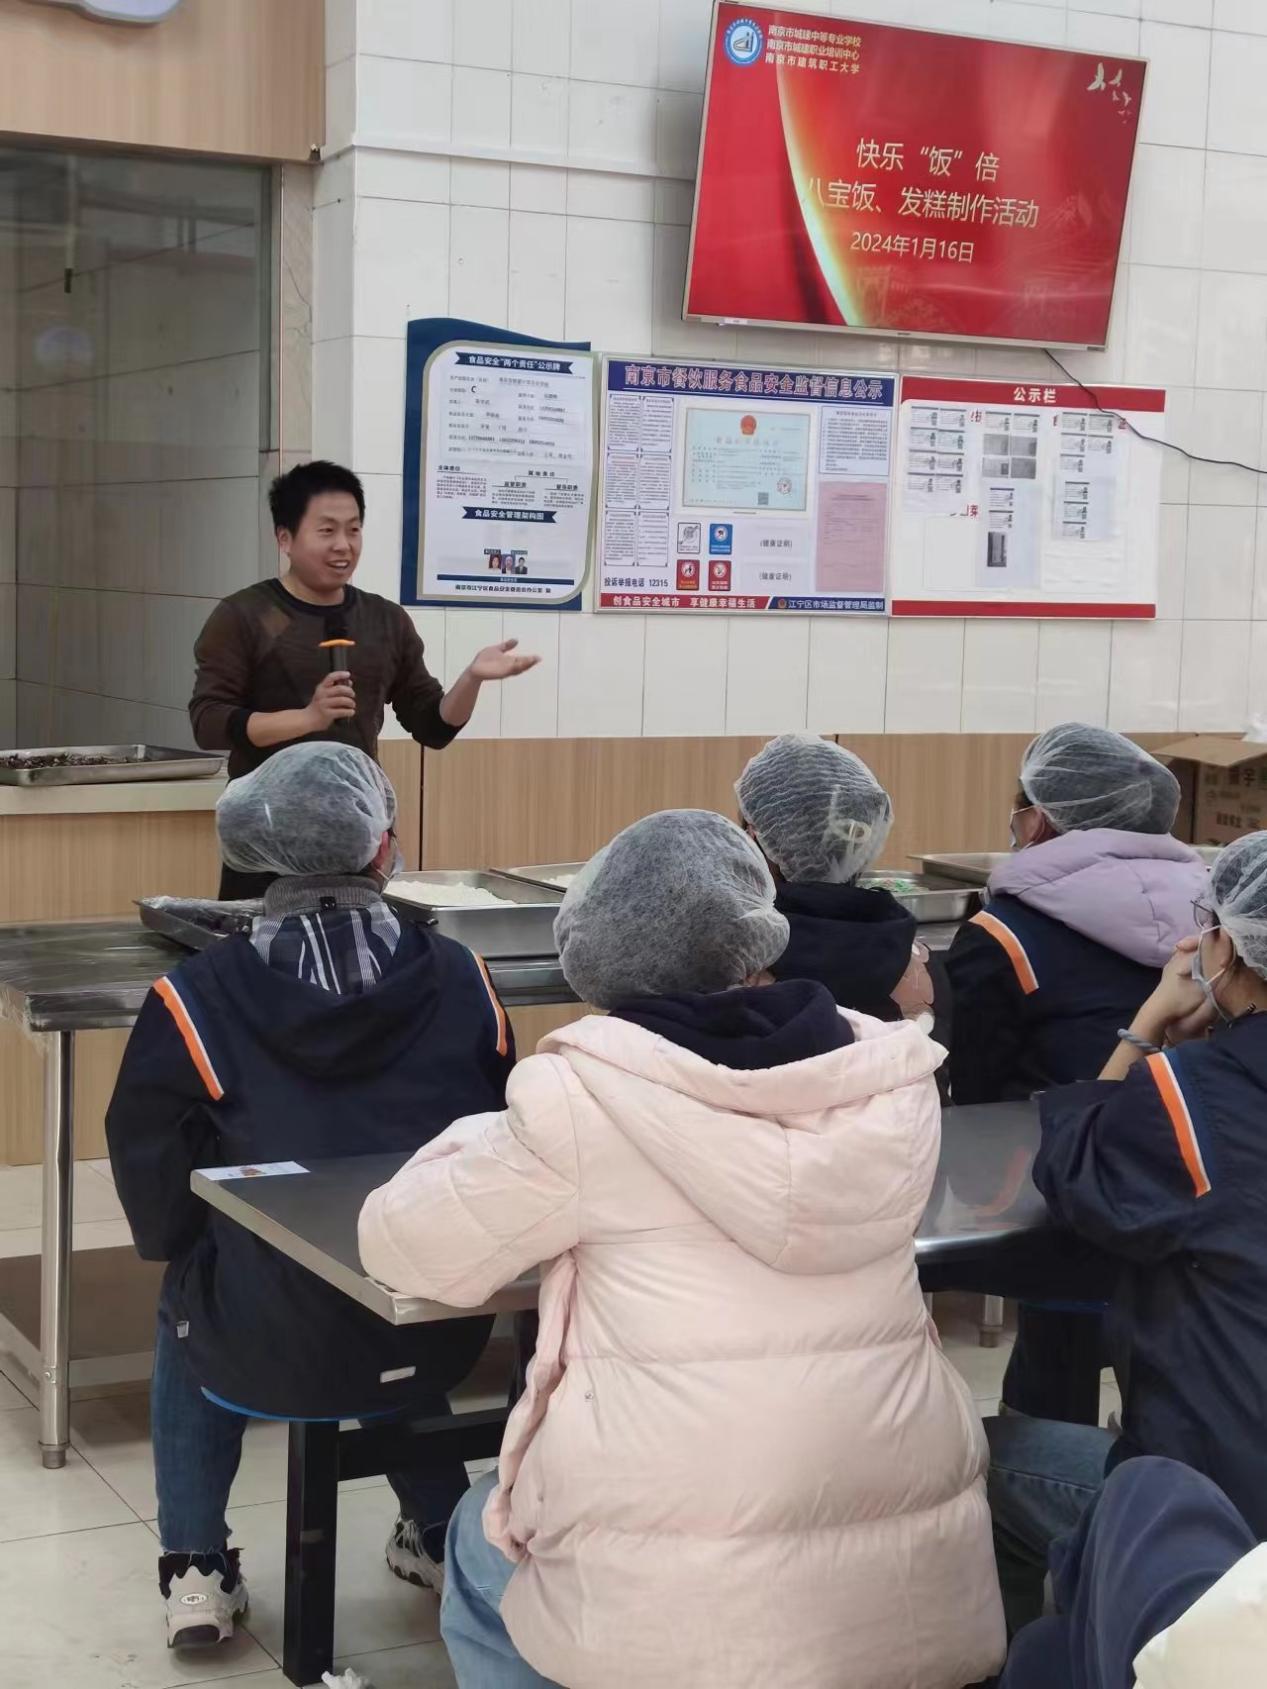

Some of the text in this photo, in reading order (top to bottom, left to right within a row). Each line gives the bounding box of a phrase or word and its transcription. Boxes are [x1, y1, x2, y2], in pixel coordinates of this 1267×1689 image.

[765, 52, 860, 74] 南京市建筑职工大学
[850, 231, 974, 264] 2024年1月16日
[624, 363, 883, 400] 南京市餐饮服务食品安全监督信息公示
[1012, 386, 1057, 404] 公示栏
[604, 577, 645, 588] 投诉举报电话
[649, 578, 669, 587] 12315
[613, 595, 680, 607] 创食品安全城市
[788, 600, 884, 610] 江宁区市场监督管理局监制
